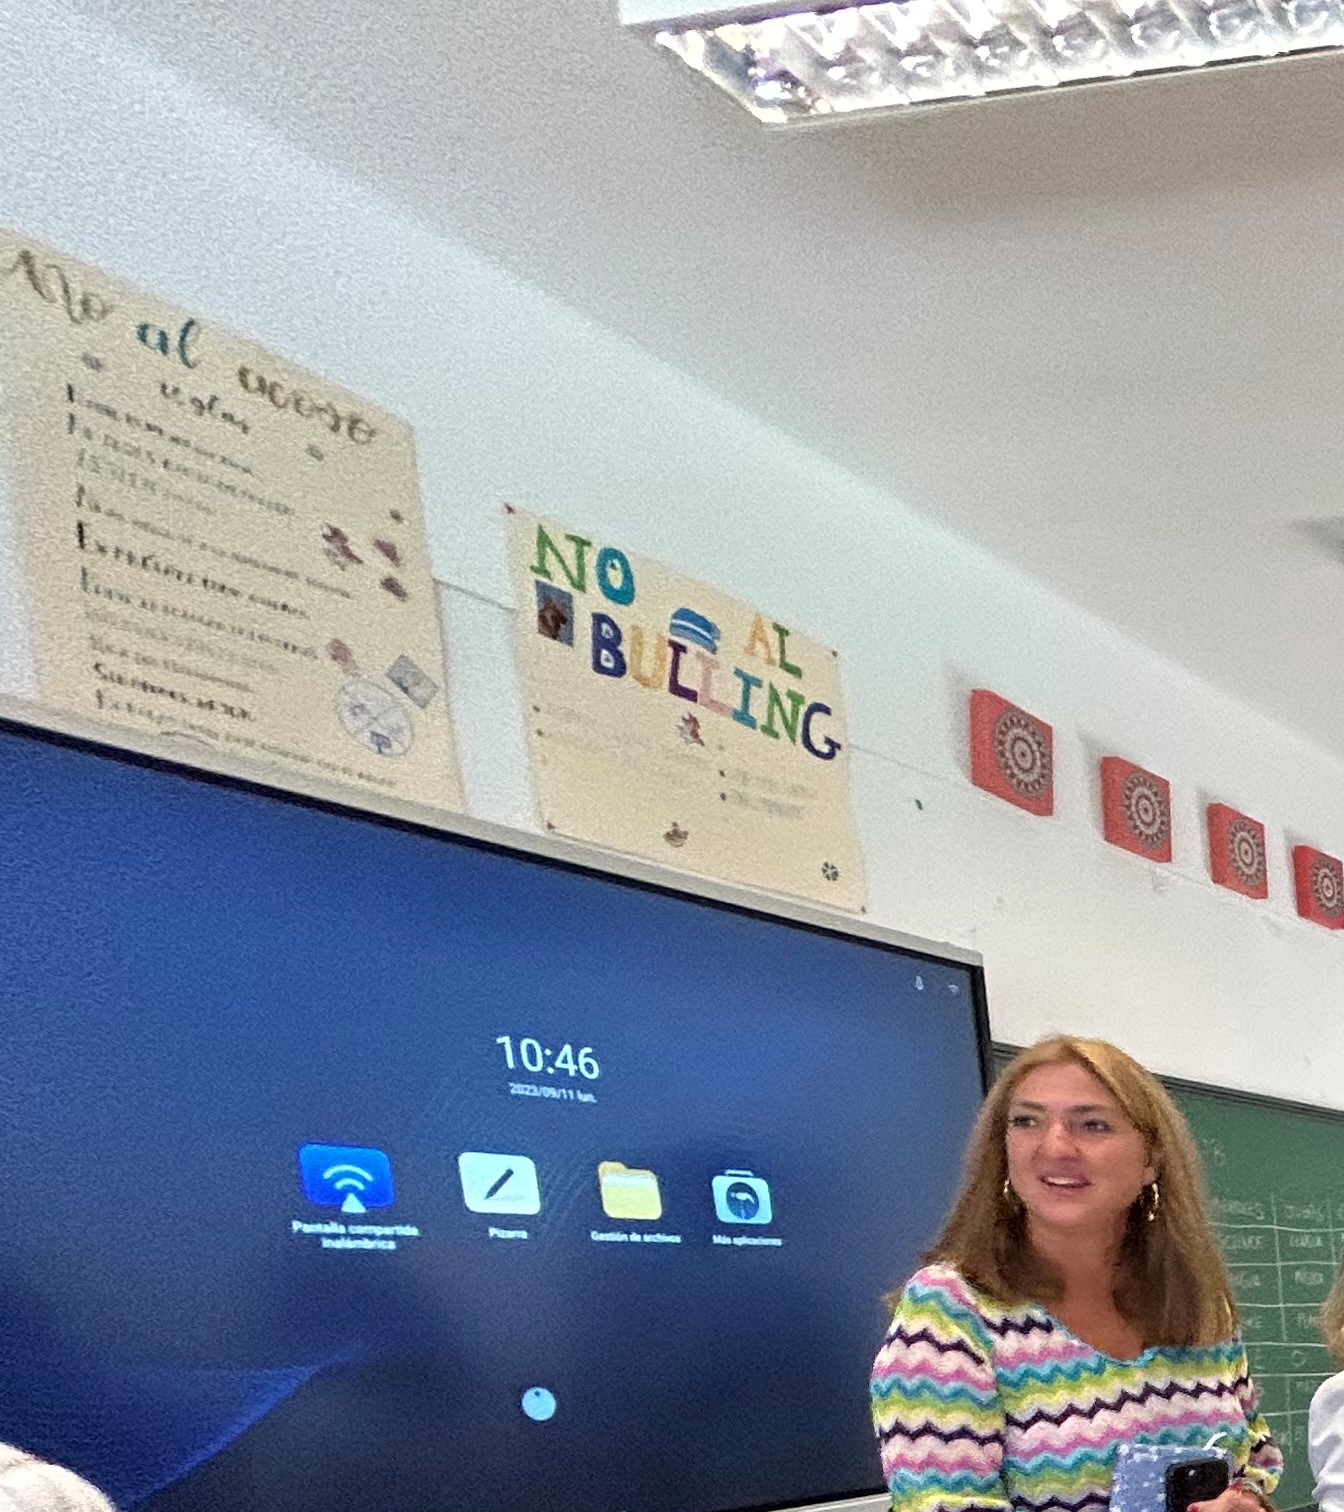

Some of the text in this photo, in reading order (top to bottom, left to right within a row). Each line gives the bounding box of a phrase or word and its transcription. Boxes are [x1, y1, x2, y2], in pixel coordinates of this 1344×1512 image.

[135, 316, 201, 369] al
[530, 524, 802, 680] NO AL
[591, 612, 842, 761] BULLING
[496, 1035, 600, 1080] 10:46
